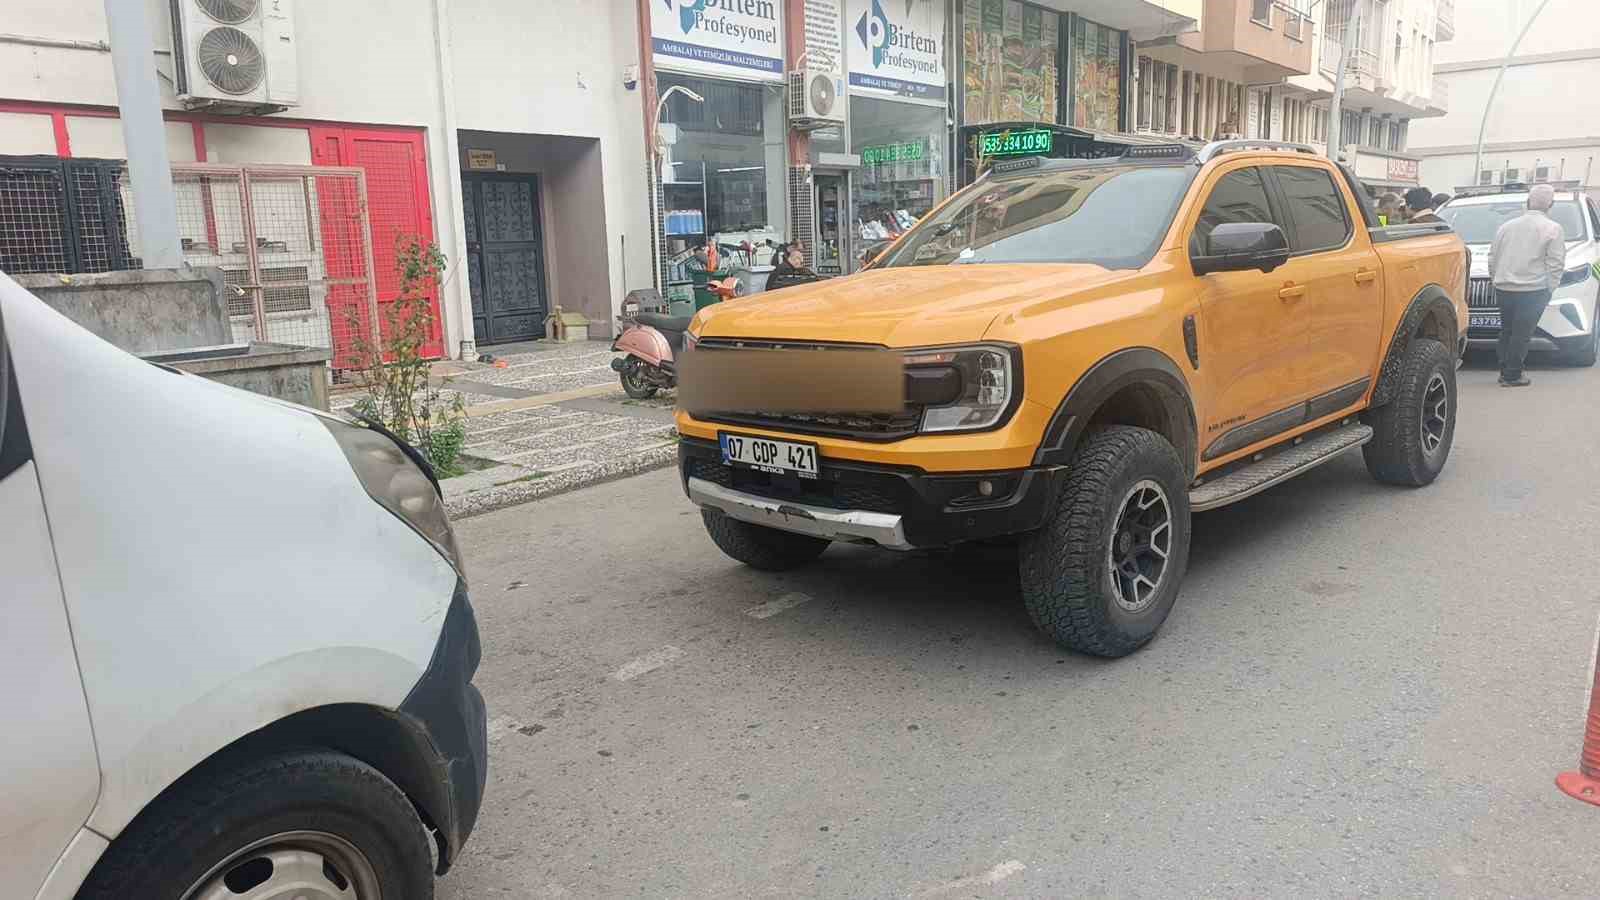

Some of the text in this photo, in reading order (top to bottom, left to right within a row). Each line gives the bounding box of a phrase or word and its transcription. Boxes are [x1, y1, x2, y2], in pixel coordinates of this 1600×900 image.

[705, 0, 775, 20] rtem
[695, 11, 776, 43] Profesyonel
[888, 24, 936, 54] Birtem
[881, 50, 938, 74] Profesyonel
[1003, 135, 1020, 151] 334
[1022, 134, 1034, 150] 10
[1035, 133, 1047, 149] 90
[728, 438, 814, 470] 07 CDP 421
